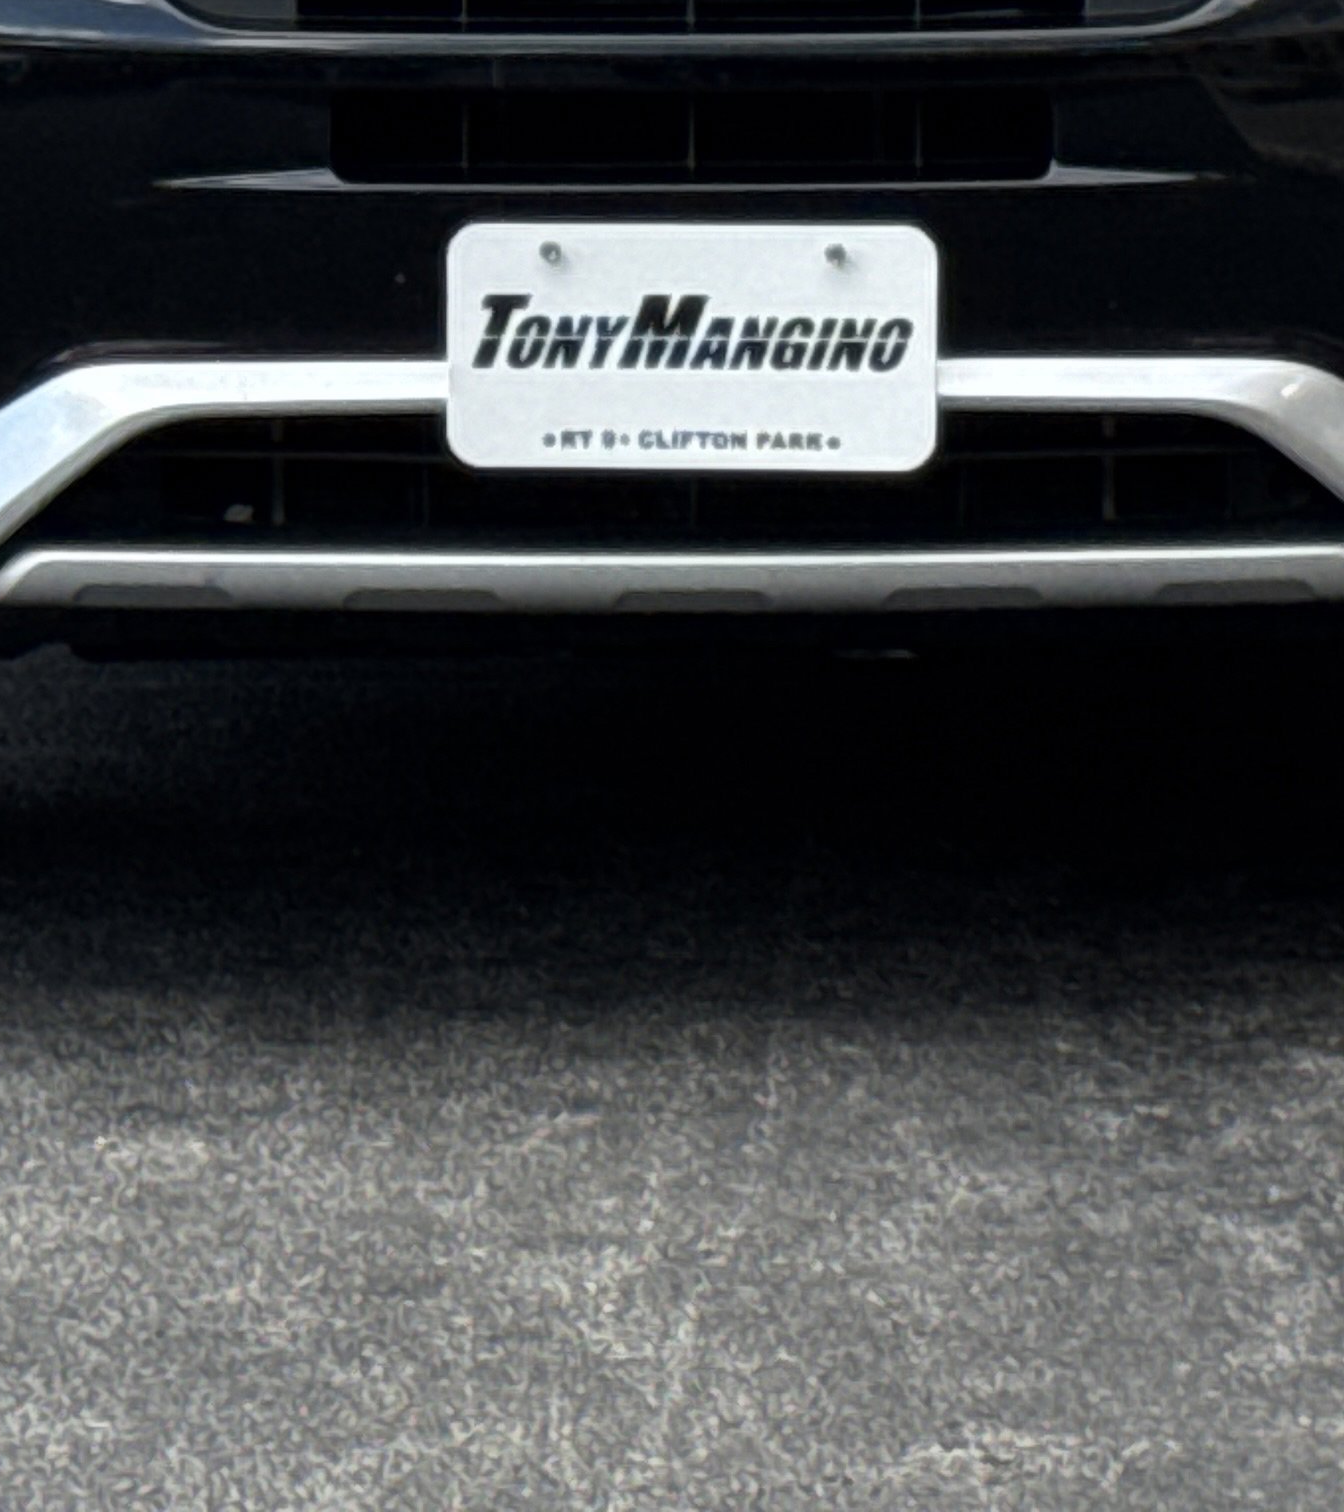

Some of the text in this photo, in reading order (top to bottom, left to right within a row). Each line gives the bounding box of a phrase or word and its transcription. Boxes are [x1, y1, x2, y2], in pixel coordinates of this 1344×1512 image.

[560, 429, 594, 450] RT
[638, 429, 748, 450] CLIFTON
[756, 431, 823, 451] PARK
